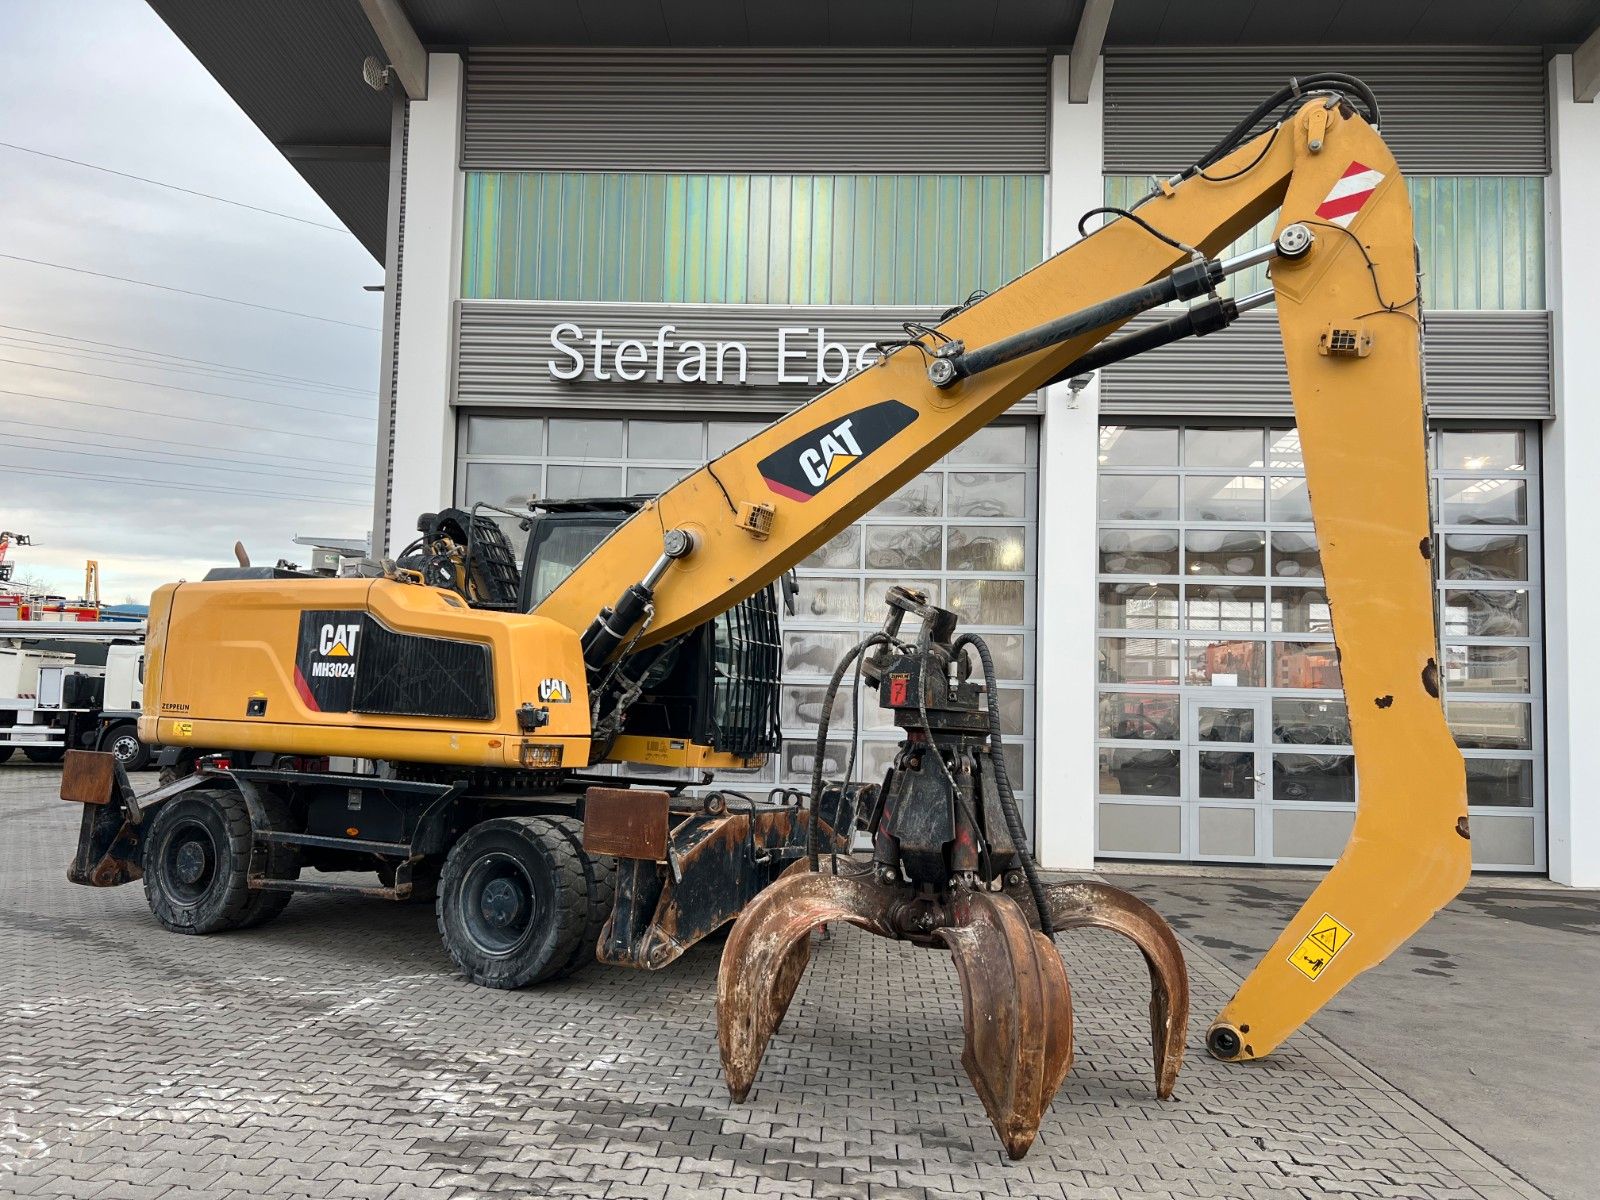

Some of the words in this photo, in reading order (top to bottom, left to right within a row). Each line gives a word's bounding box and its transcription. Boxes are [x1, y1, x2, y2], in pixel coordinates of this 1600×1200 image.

[548, 323, 747, 383] Stefan
[799, 418, 863, 487] CAT
[319, 624, 360, 656] CAT
[312, 662, 355, 677] MH3024
[540, 679, 568, 700] CAT
[161, 703, 190, 711] ZEPPELIN
